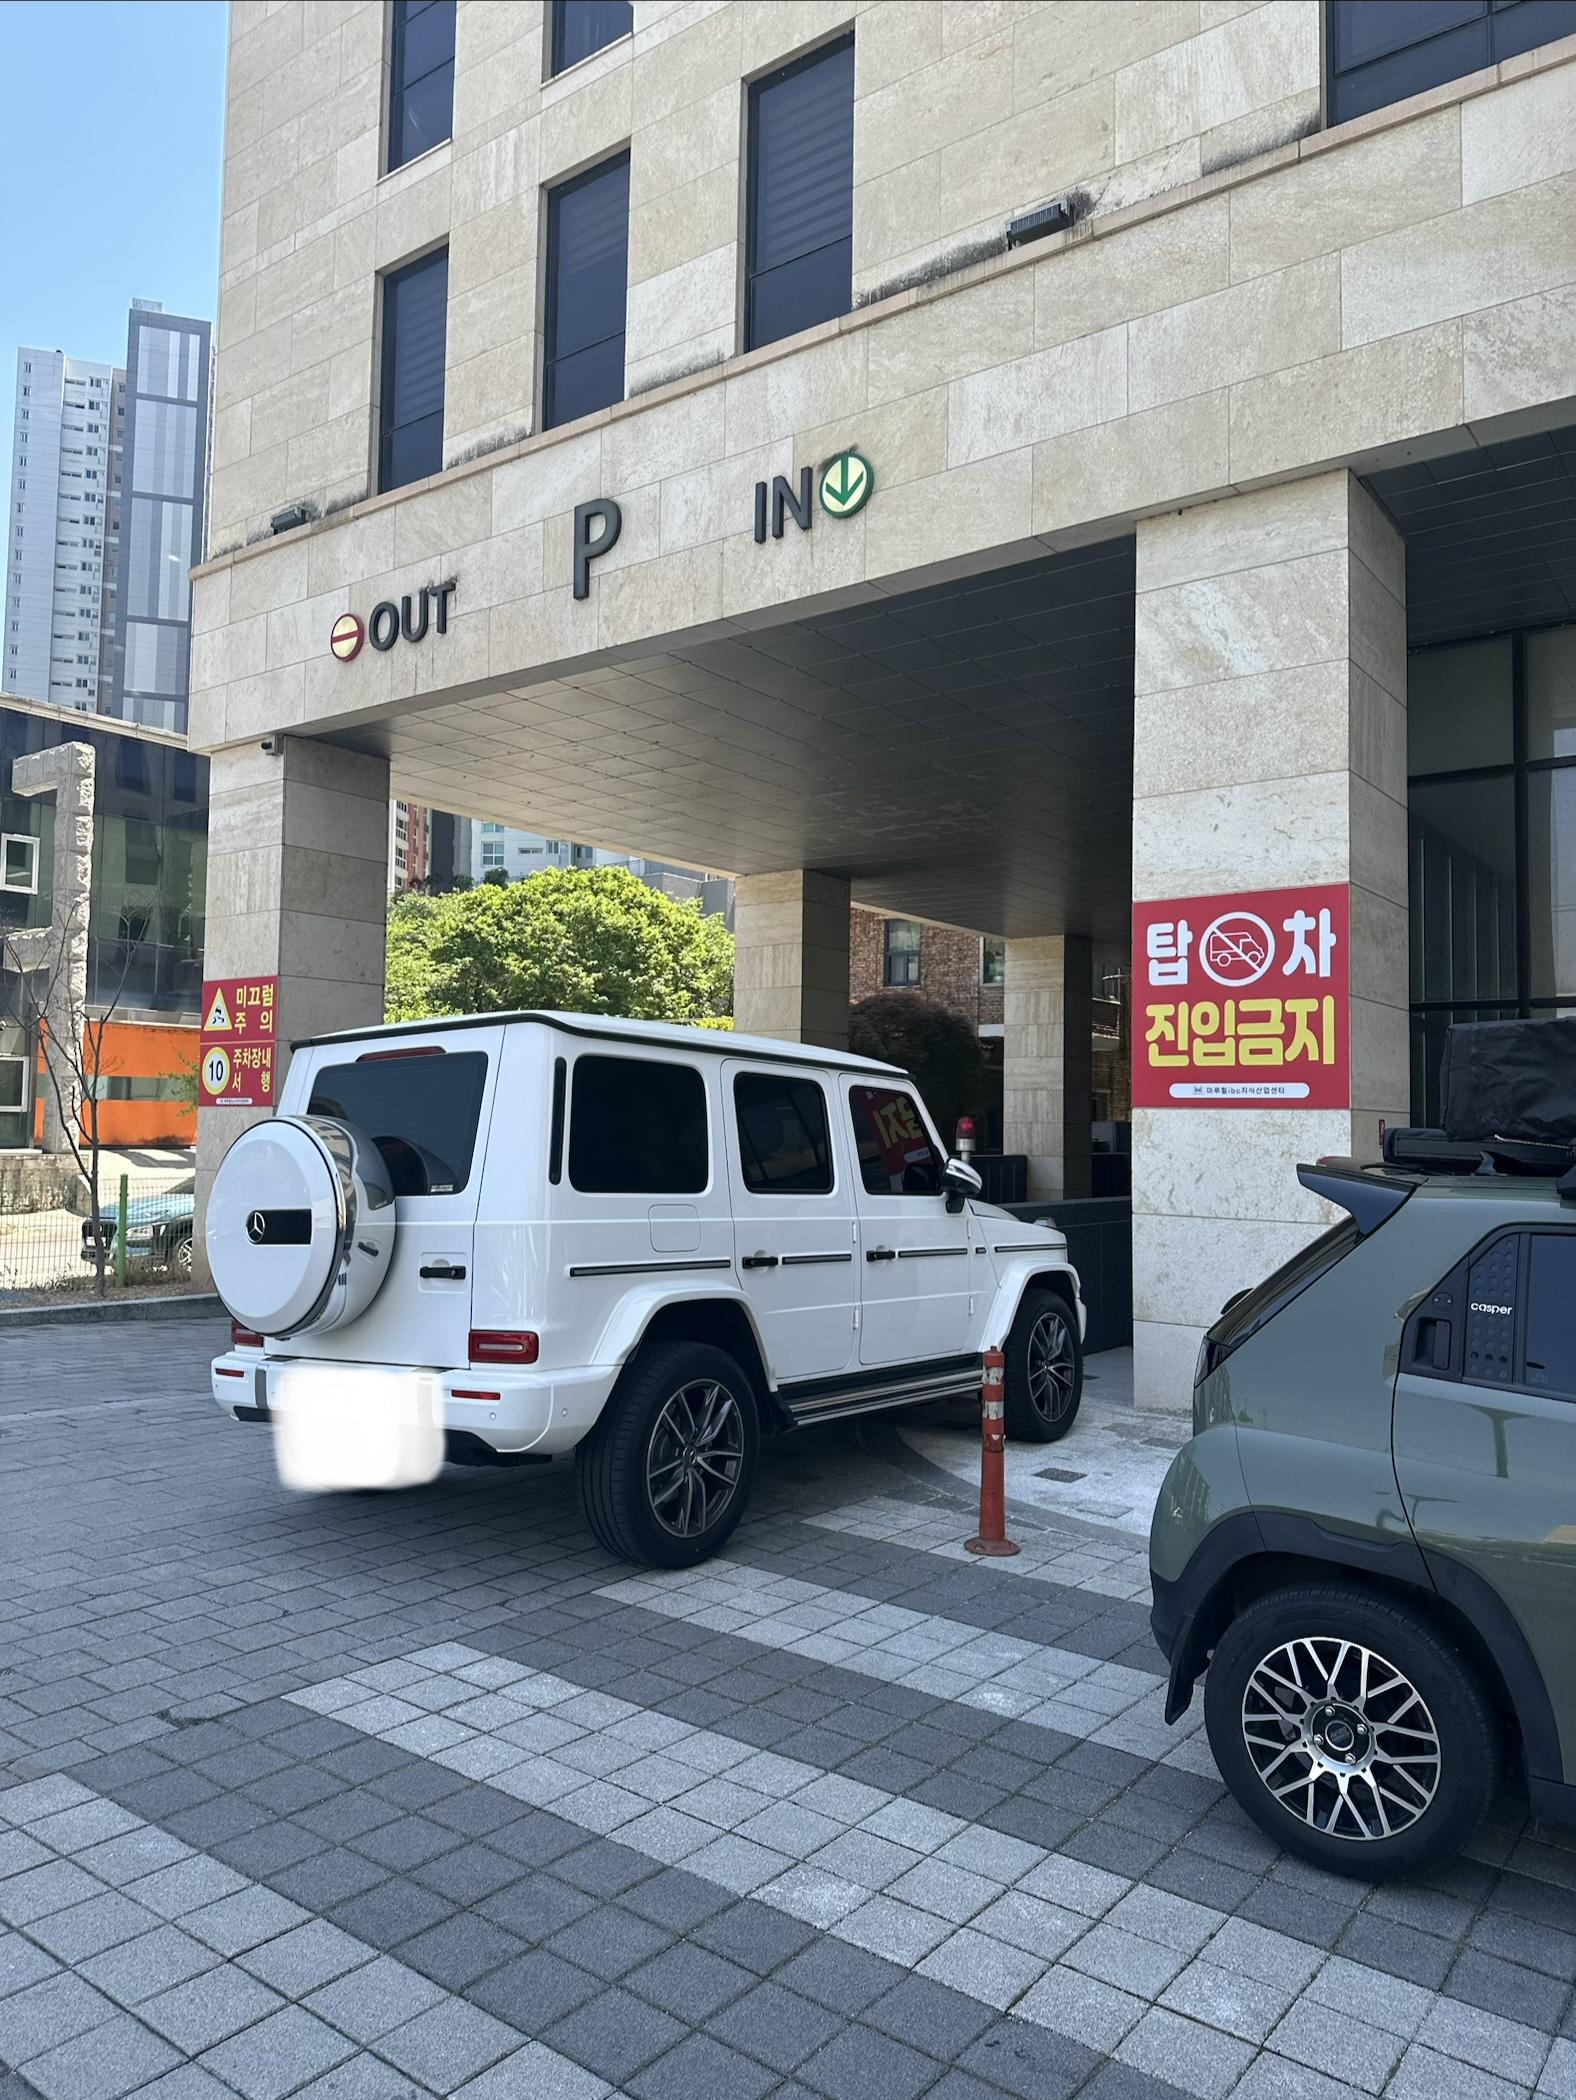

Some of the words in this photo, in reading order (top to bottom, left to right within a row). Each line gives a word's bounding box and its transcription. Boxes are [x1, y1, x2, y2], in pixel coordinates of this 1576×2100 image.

[754, 466, 813, 544] IN
[573, 498, 622, 600] P
[369, 580, 457, 651] OUT
[1146, 919, 1194, 987] 탑
[1282, 907, 1337, 978] 차
[235, 983, 274, 1009] 미끄럼
[1145, 994, 1336, 1068] 진입금지
[208, 1059, 224, 1082] 10
[232, 1046, 272, 1070] 주차장내
[1470, 1302, 1513, 1316] casper
